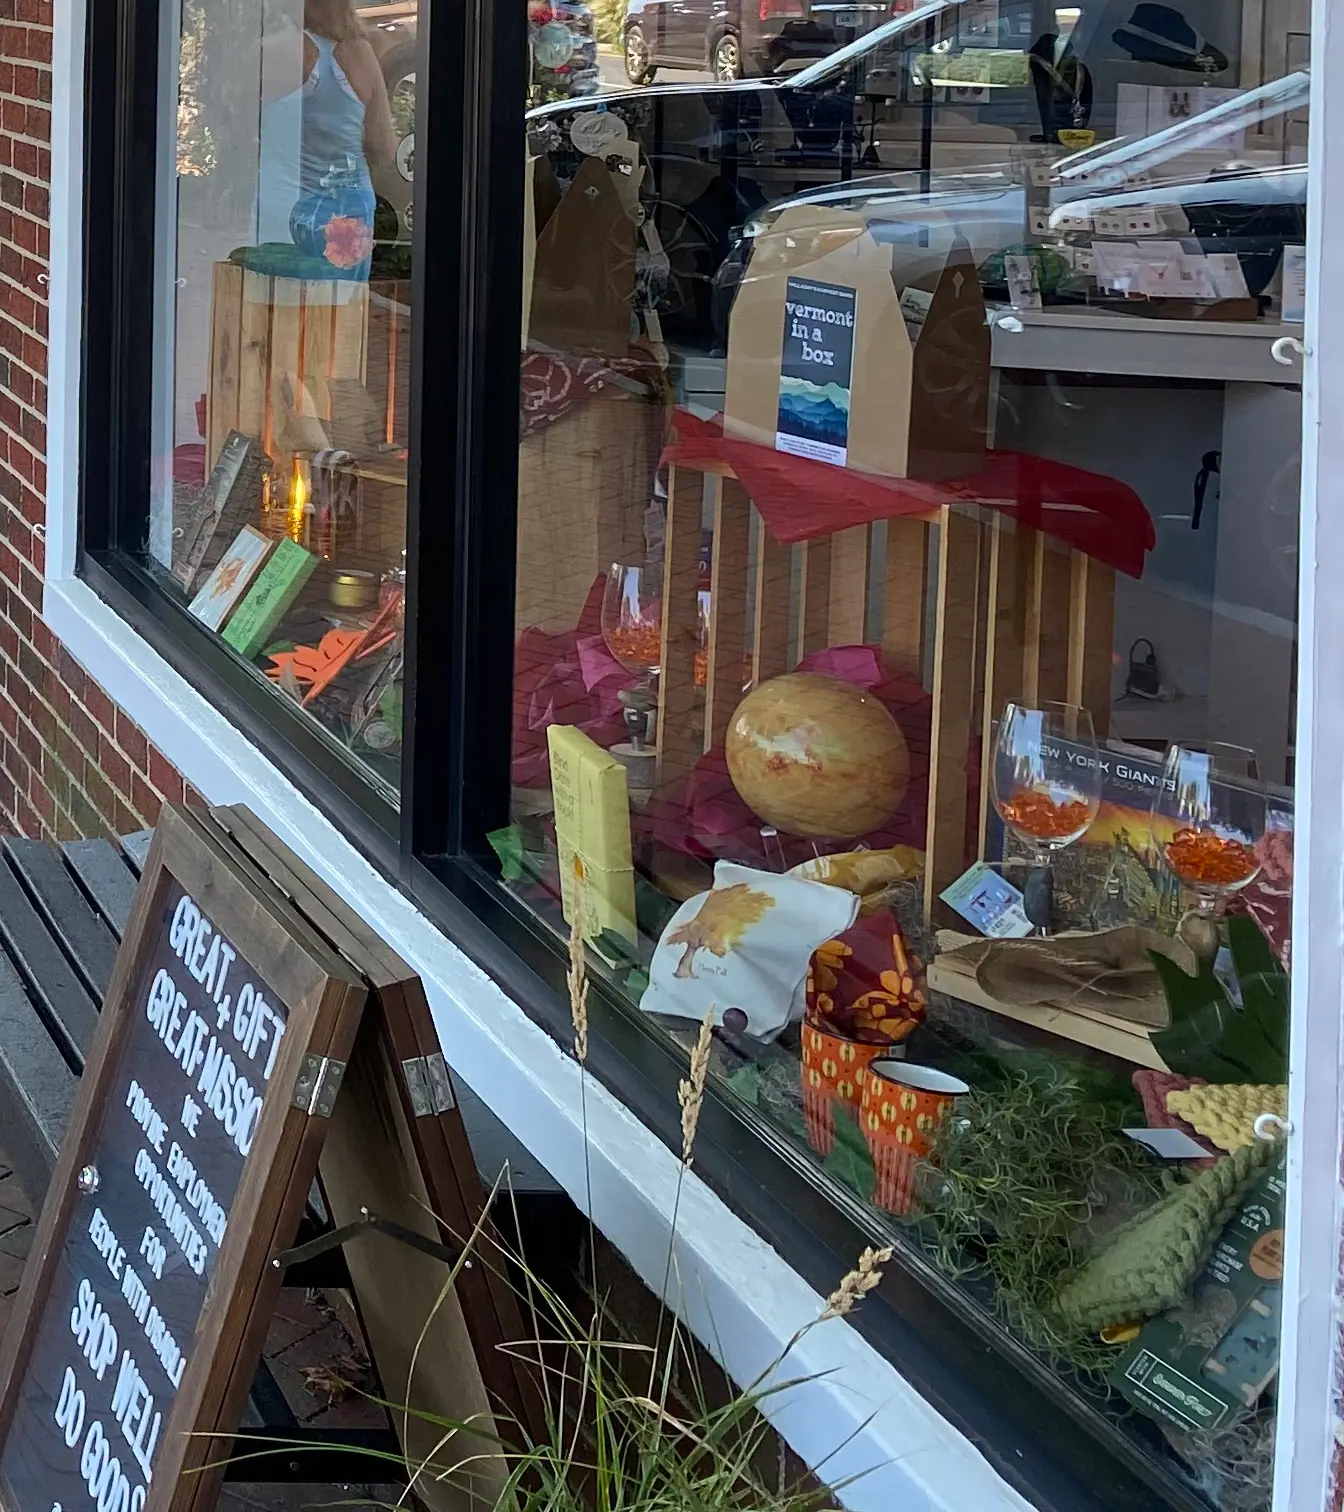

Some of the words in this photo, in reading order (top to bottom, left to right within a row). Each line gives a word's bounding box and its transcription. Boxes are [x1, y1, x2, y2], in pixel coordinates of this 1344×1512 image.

[785, 302, 854, 328] vermont
[791, 318, 809, 340] in
[812, 327, 823, 343] a
[801, 341, 834, 366] box
[1027, 741, 1060, 760] NEW
[1066, 750, 1110, 774] YORK
[1116, 764, 1177, 793] GIANTS
[169, 894, 236, 1004] GREAT
[146, 968, 210, 1078] GREAT
[125, 1080, 169, 1156] PROVIDE
[180, 1092, 203, 1139] WE
[134, 1147, 208, 1276] OPPORTUNITIES
[88, 1207, 127, 1281] PEOPLE
[121, 1264, 151, 1325] WITH
[139, 1225, 167, 1281] FOR
[54, 1366, 86, 1449] DO
[70, 1278, 118, 1382] SHOP
[110, 1349, 162, 1484] WELL
